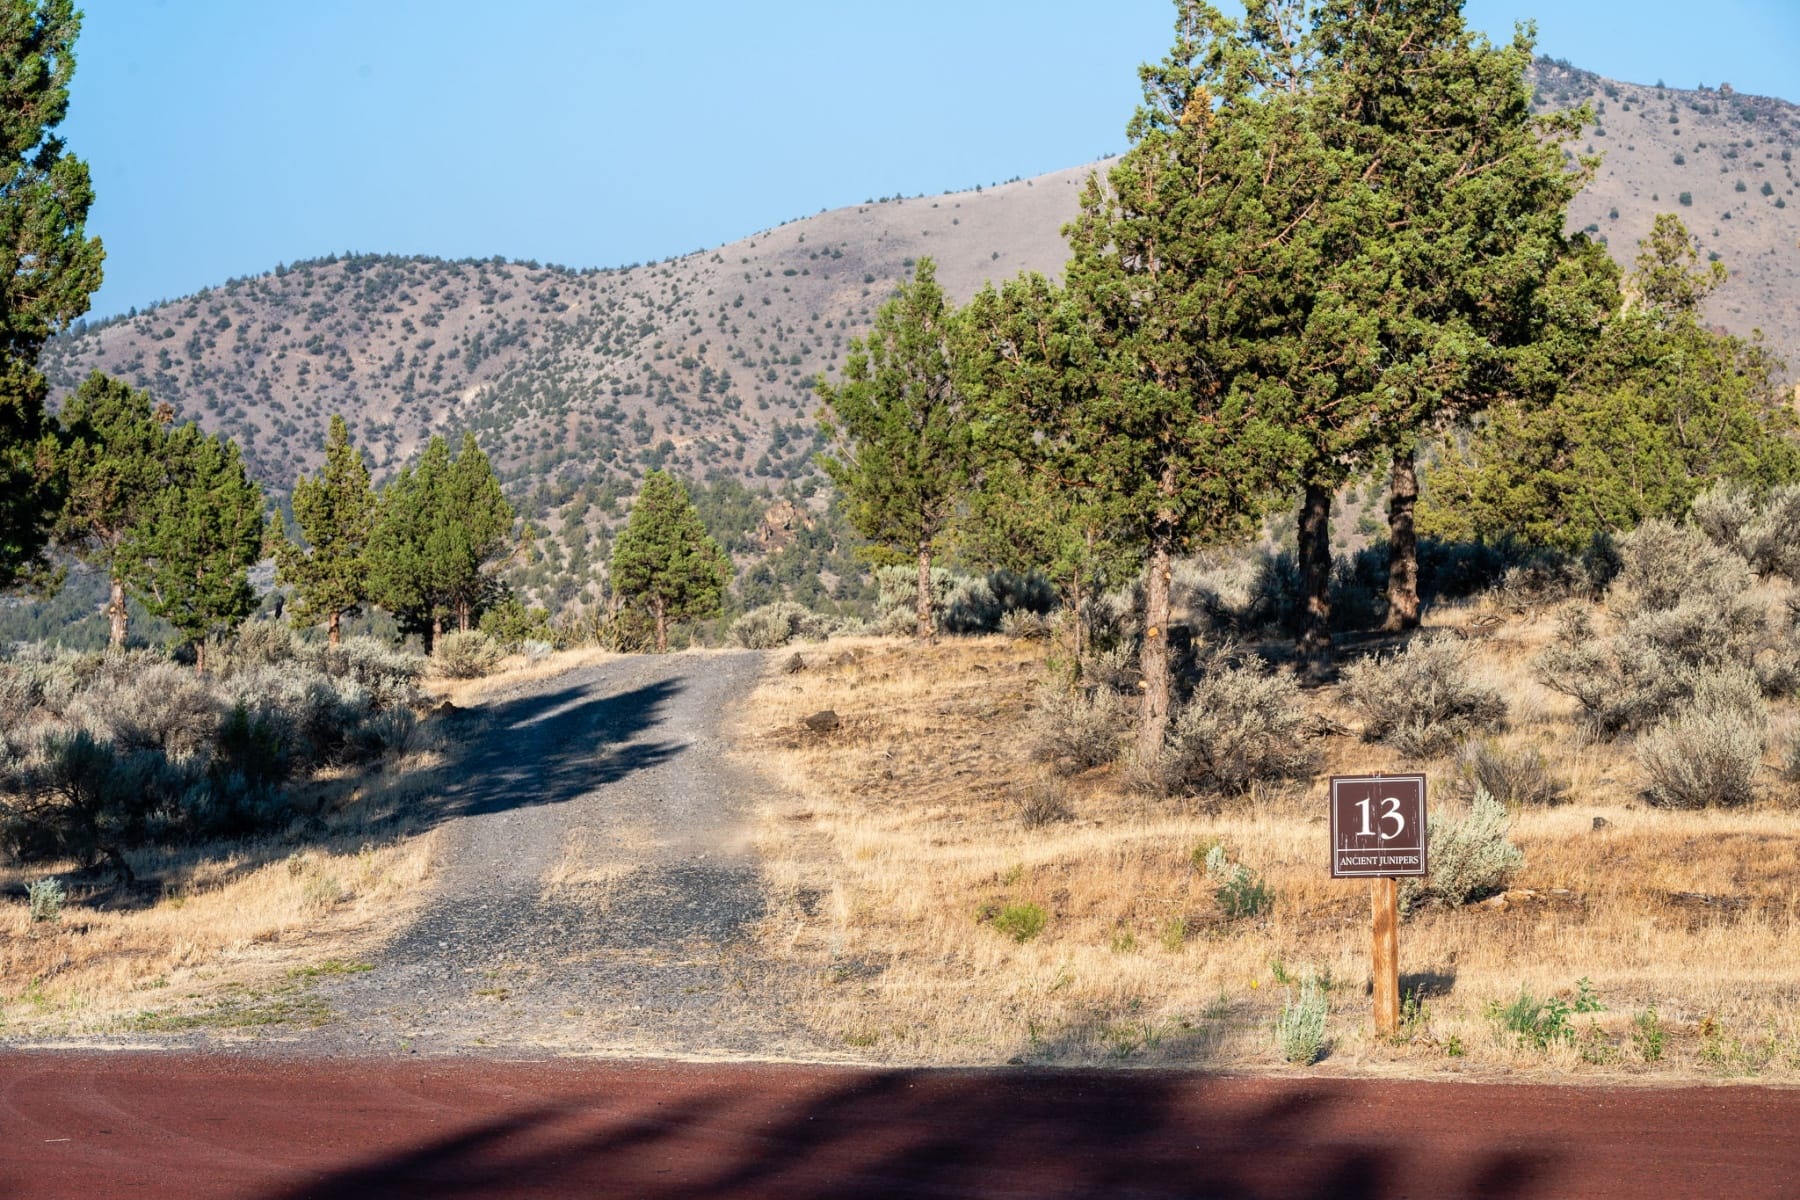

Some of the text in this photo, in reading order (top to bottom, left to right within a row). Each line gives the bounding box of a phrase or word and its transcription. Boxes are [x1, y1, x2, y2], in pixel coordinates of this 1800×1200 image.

[1354, 797, 1405, 840] 13
[1340, 855, 1419, 866] ANCIENT JUNIPERS
